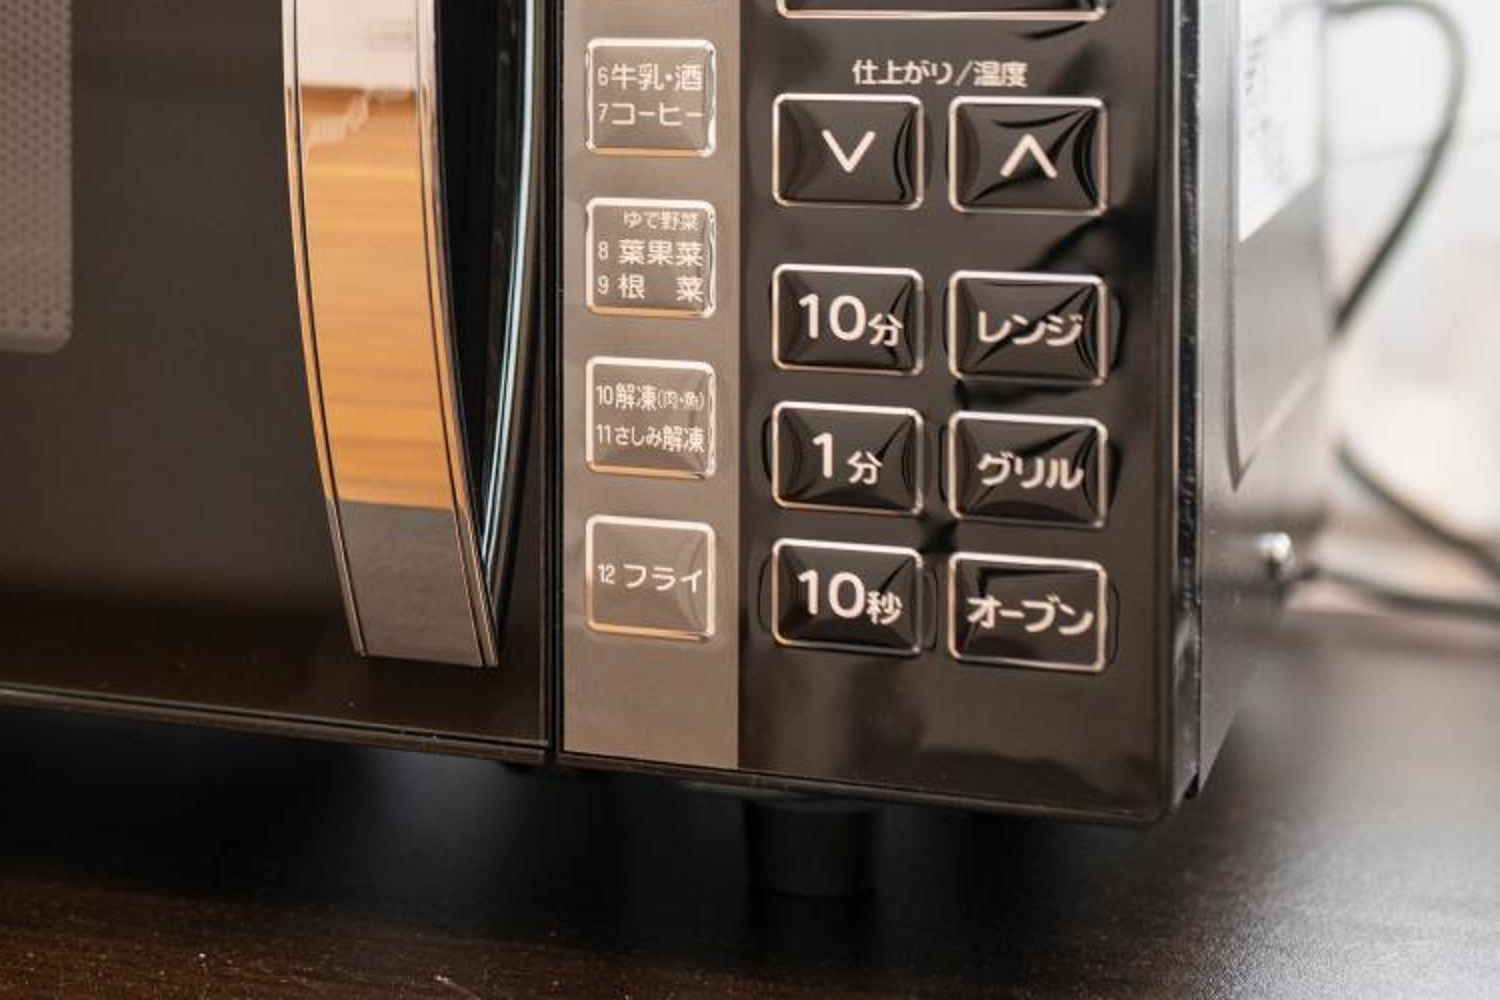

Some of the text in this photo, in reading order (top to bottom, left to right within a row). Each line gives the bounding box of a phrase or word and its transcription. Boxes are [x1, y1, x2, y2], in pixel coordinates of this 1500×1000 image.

[852, 59, 1027, 87] 仕上がり/温度
[597, 240, 609, 260] 8
[799, 293, 903, 346] 10分
[978, 311, 1083, 347] レンジ
[977, 451, 1084, 490] グリル
[597, 564, 703, 593] 12 フライ
[798, 569, 903, 625] 10秒
[967, 595, 1094, 635] オーブン
